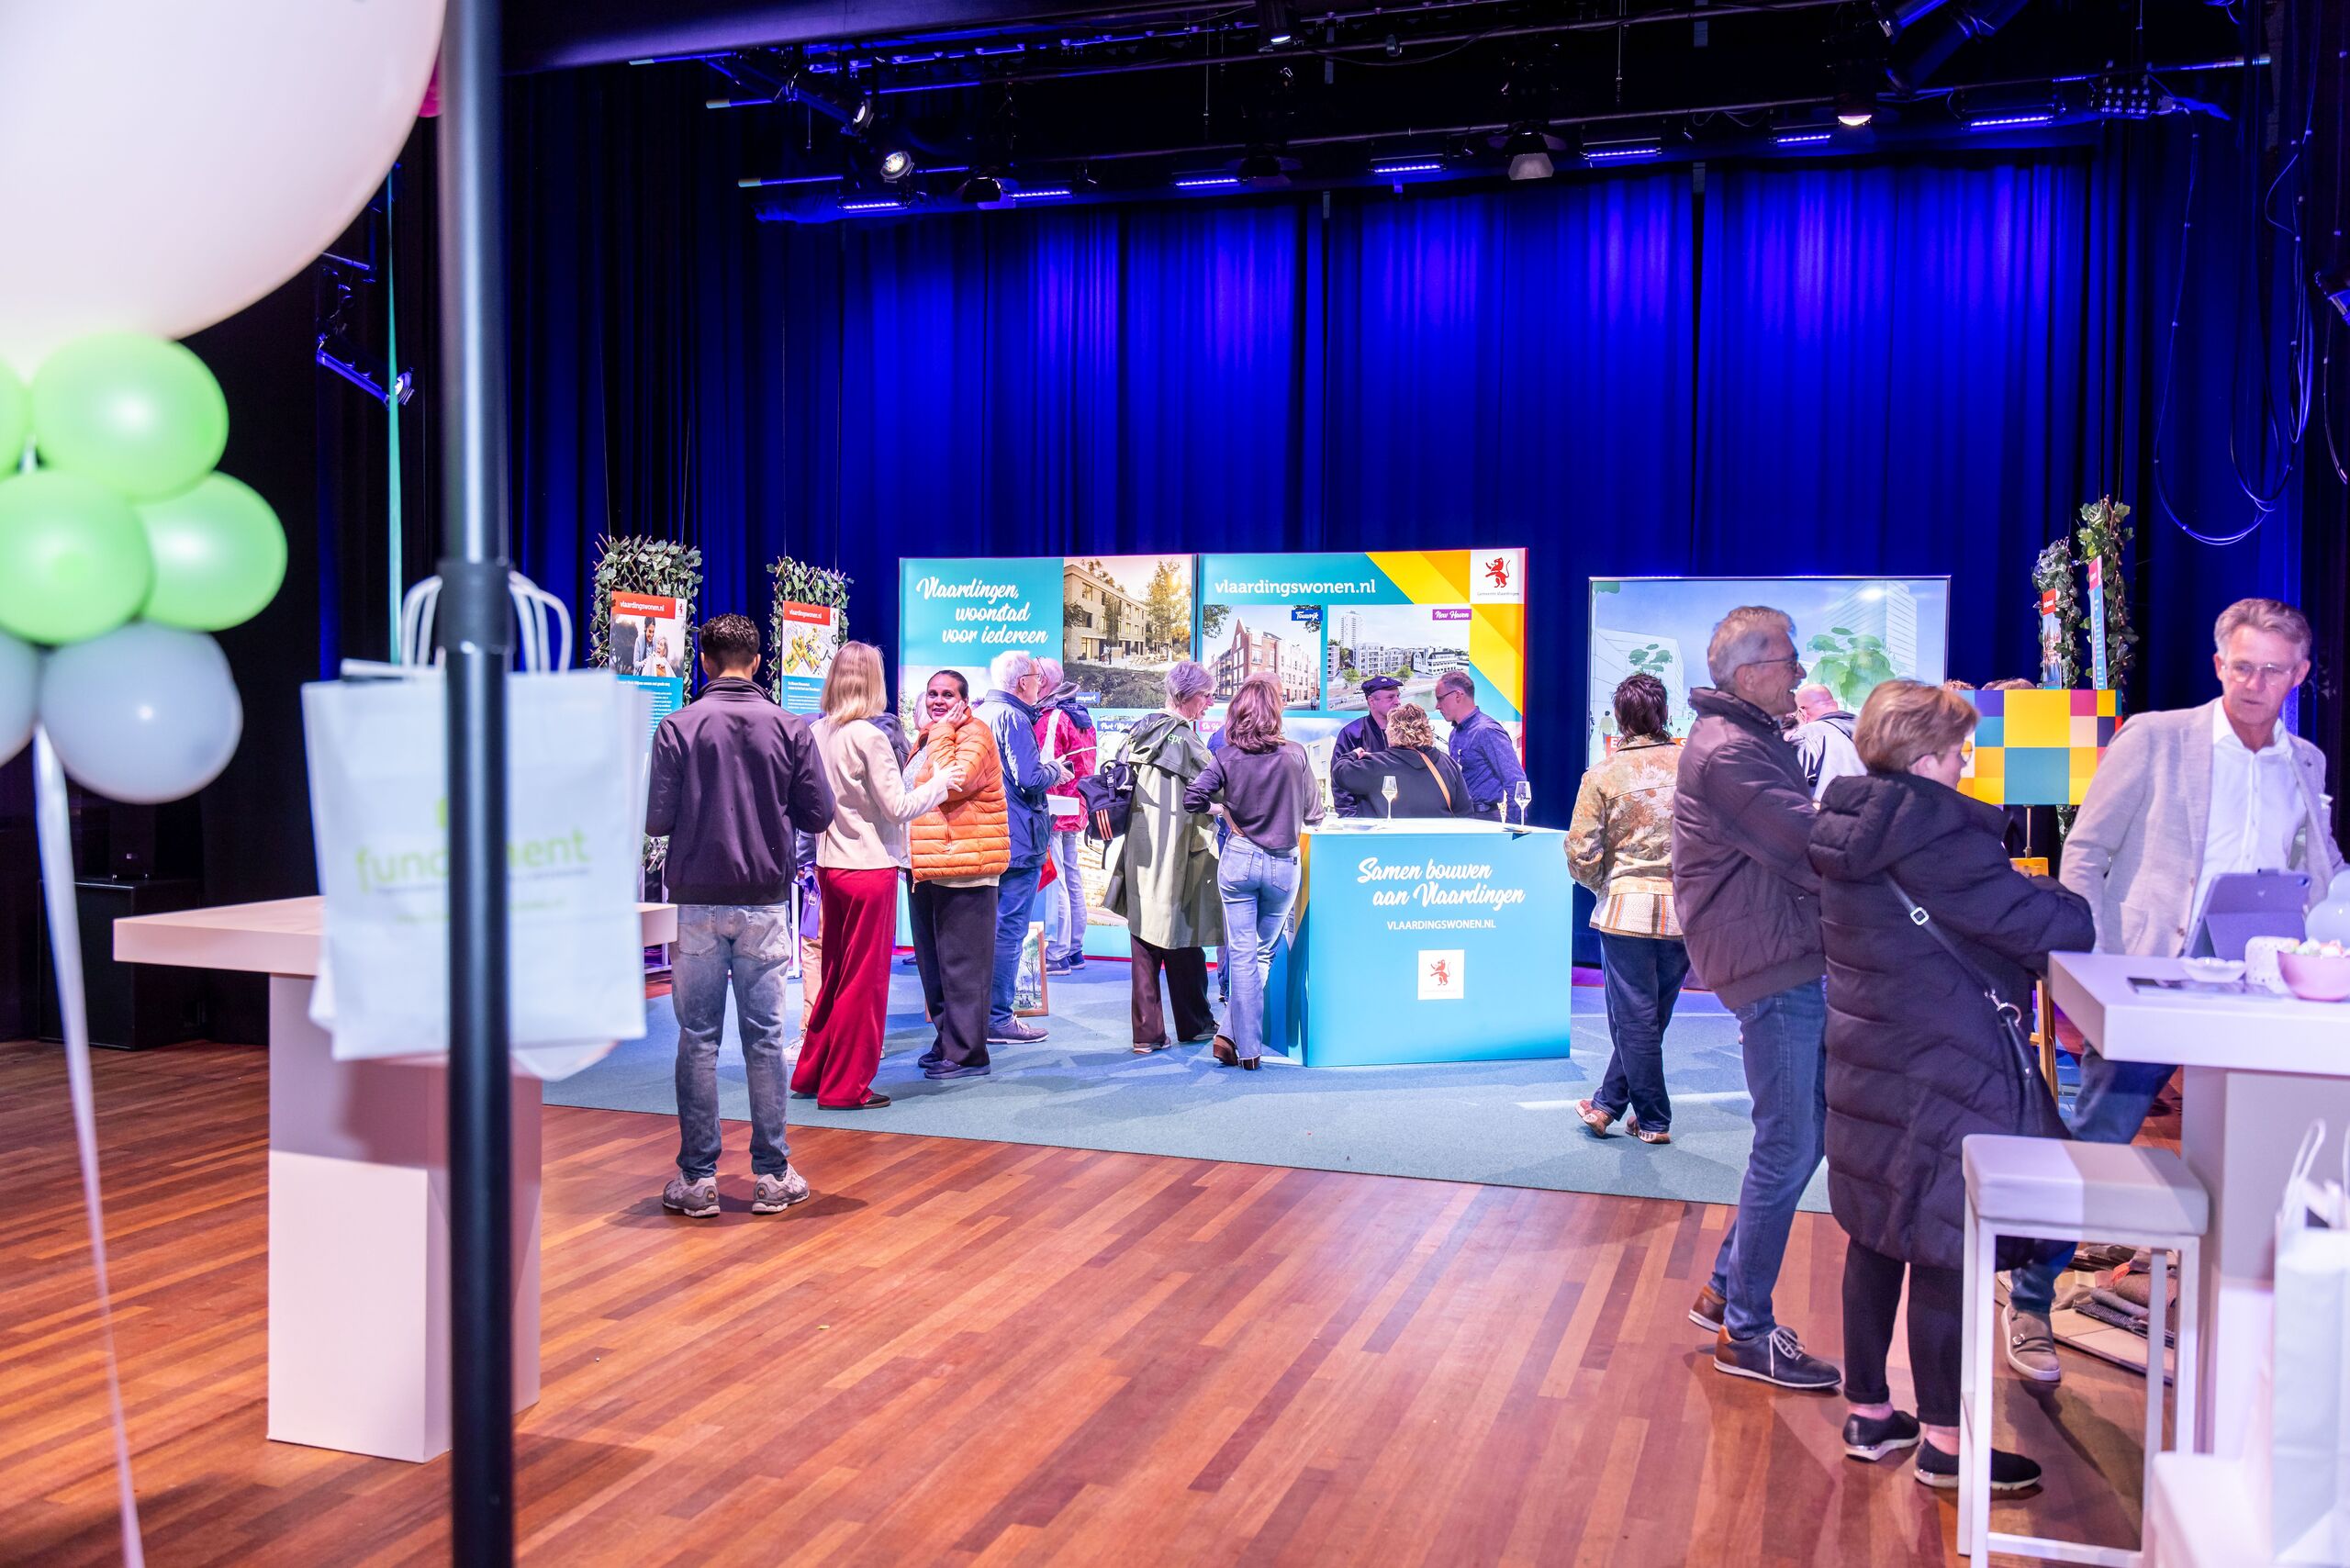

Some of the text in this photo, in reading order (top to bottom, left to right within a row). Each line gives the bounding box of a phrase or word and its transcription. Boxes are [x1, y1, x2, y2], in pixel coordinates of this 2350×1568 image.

[916, 577, 1019, 605] Vlaardingen,
[1214, 579, 1376, 597] vlaardingswonen.nl
[620, 600, 665, 611] vlaardingswonen.nl
[956, 602, 1031, 622] woonstad
[942, 624, 1048, 644] voor iedereen
[1358, 857, 1492, 884] Samen bouwen
[1373, 882, 1526, 911] aan Vlaardingen
[1387, 919, 1496, 930] VLAARDINGSWONEN.NL
